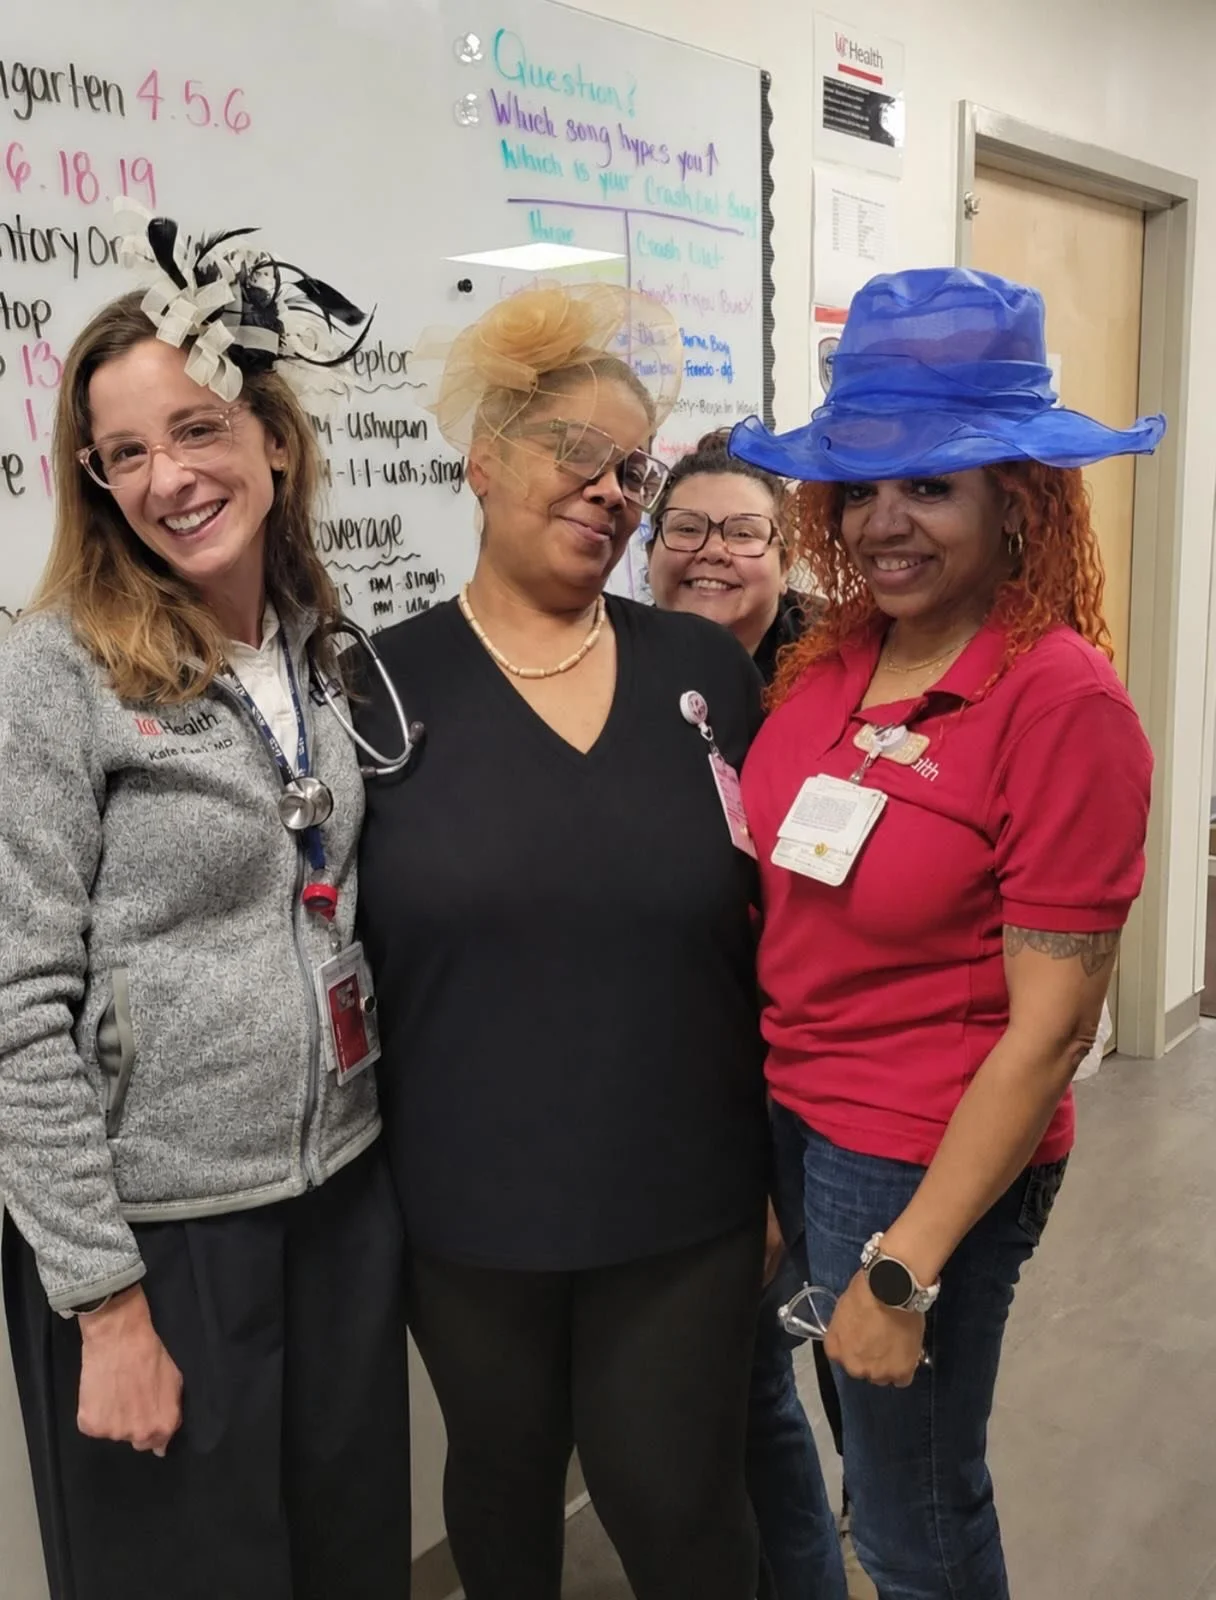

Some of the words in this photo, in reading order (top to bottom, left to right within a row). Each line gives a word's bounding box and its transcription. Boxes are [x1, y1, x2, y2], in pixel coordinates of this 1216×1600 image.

[849, 41, 884, 69] Health
[0, 60, 126, 121] garten
[490, 88, 557, 138] Which
[566, 119, 612, 169] song
[618, 122, 671, 167] hypes
[677, 151, 704, 182] you
[500, 139, 564, 178] Which
[315, 513, 405, 559] overage
[158, 711, 219, 737] Health
